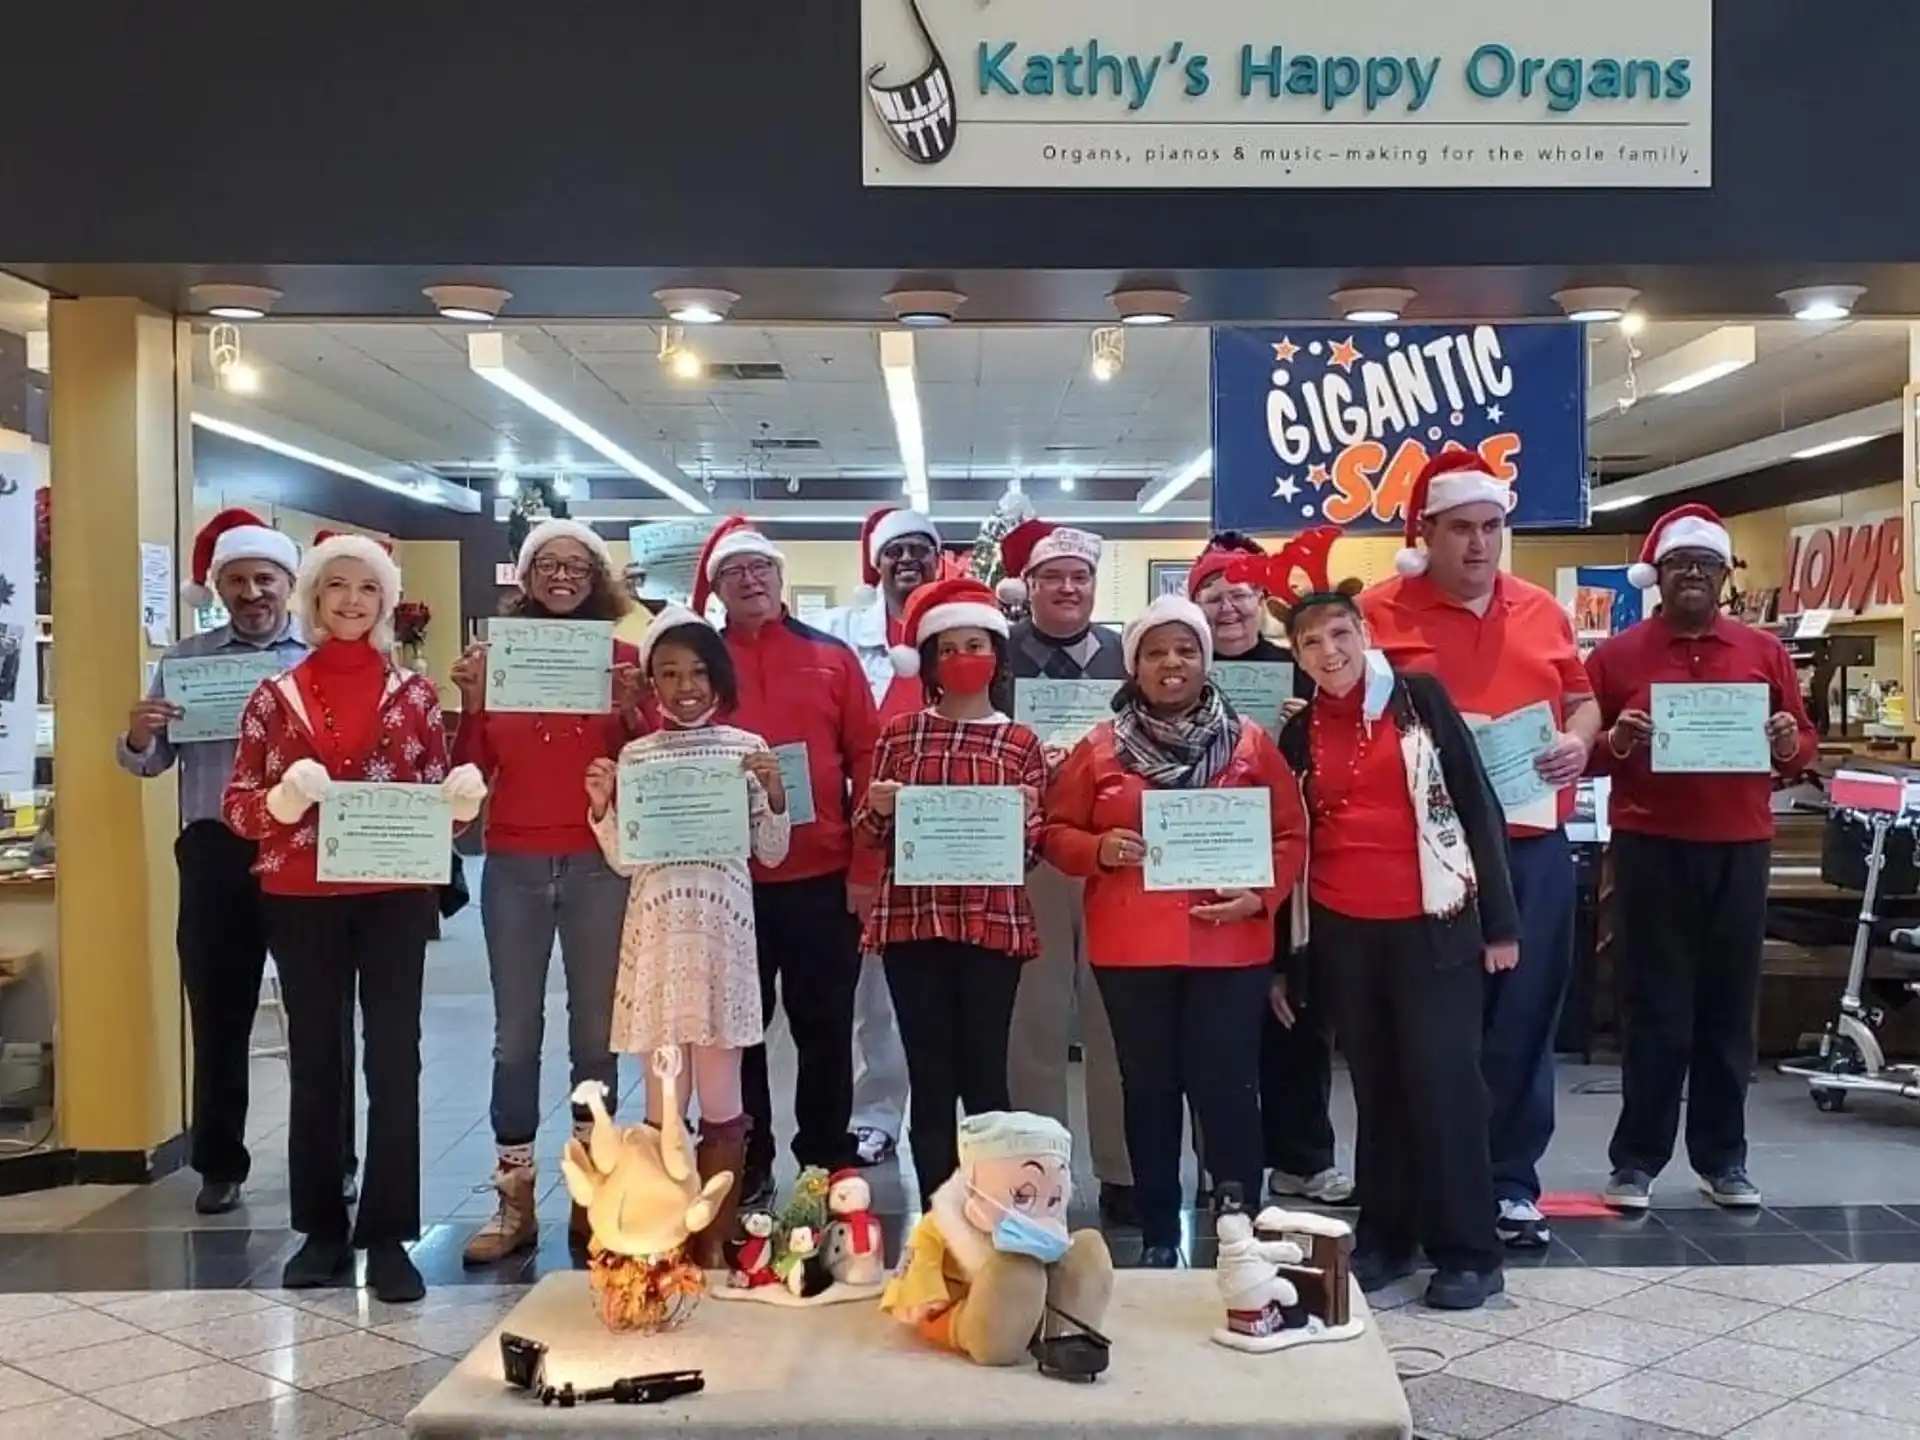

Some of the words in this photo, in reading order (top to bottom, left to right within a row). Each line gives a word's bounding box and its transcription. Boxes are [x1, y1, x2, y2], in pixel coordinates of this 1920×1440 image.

[977, 41, 1211, 110] Kathy's
[1239, 44, 1440, 111] Happy
[1465, 43, 1691, 112] Organs
[1042, 144, 1131, 164] Organs,
[1145, 144, 1220, 163] pianos
[1232, 146, 1245, 161] &
[1441, 144, 1474, 161] for
[1488, 144, 1524, 161] the
[1537, 144, 1604, 161] whole
[1618, 144, 1689, 164] family
[1266, 325, 1513, 465] GIGANTIC
[1322, 432, 1522, 524] SAE
